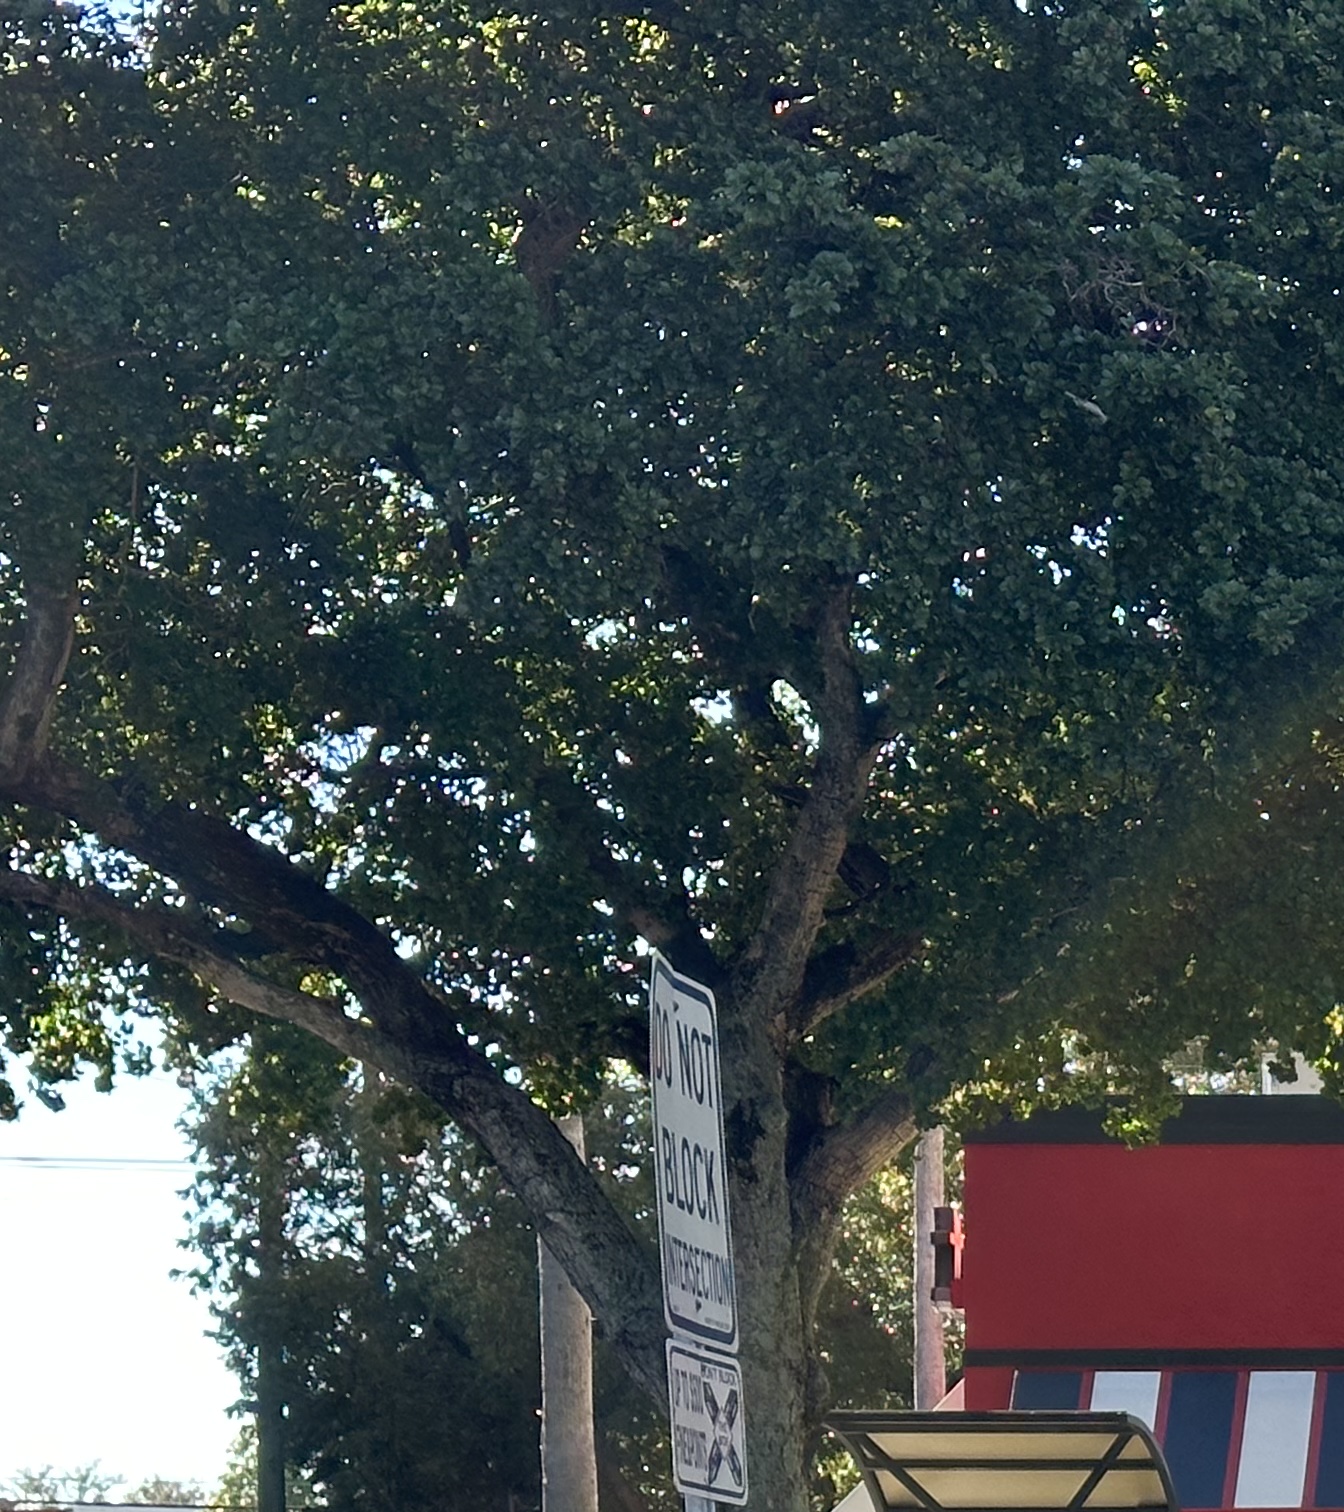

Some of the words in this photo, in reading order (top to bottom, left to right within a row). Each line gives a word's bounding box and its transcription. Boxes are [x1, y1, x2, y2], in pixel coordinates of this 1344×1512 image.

[655, 1001, 672, 1088] DO
[676, 1019, 713, 1108] NOT
[662, 1126, 720, 1225] BLOCK
[666, 1232, 734, 1306] INTERSECTION
